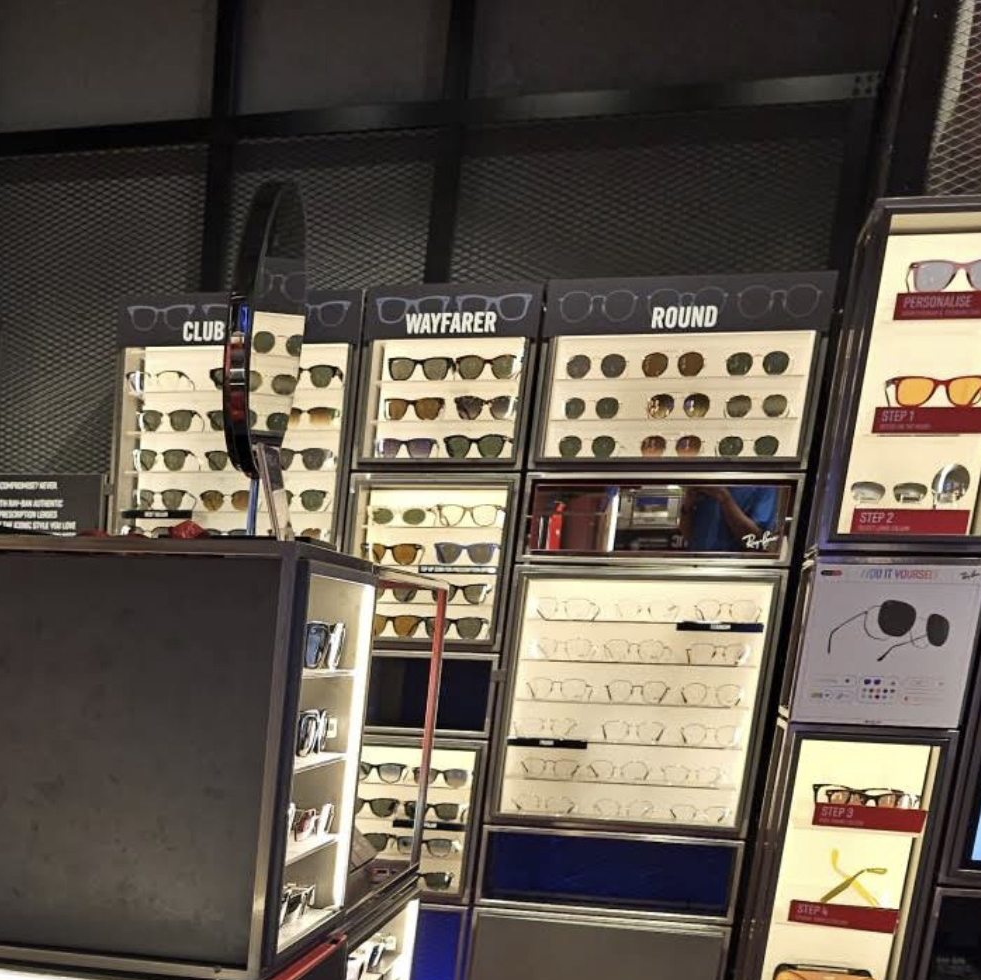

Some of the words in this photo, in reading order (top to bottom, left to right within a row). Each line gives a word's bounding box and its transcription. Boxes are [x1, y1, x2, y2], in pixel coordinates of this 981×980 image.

[903, 294, 973, 309] PERSONALISE
[406, 311, 497, 335] WAYFARER
[651, 305, 719, 329] ROUND
[182, 321, 226, 342] CLUB
[882, 411, 907, 422] STEP
[909, 411, 915, 422] 1
[860, 512, 885, 523] STEP
[886, 512, 894, 523] 2
[821, 806, 845, 818] STEP
